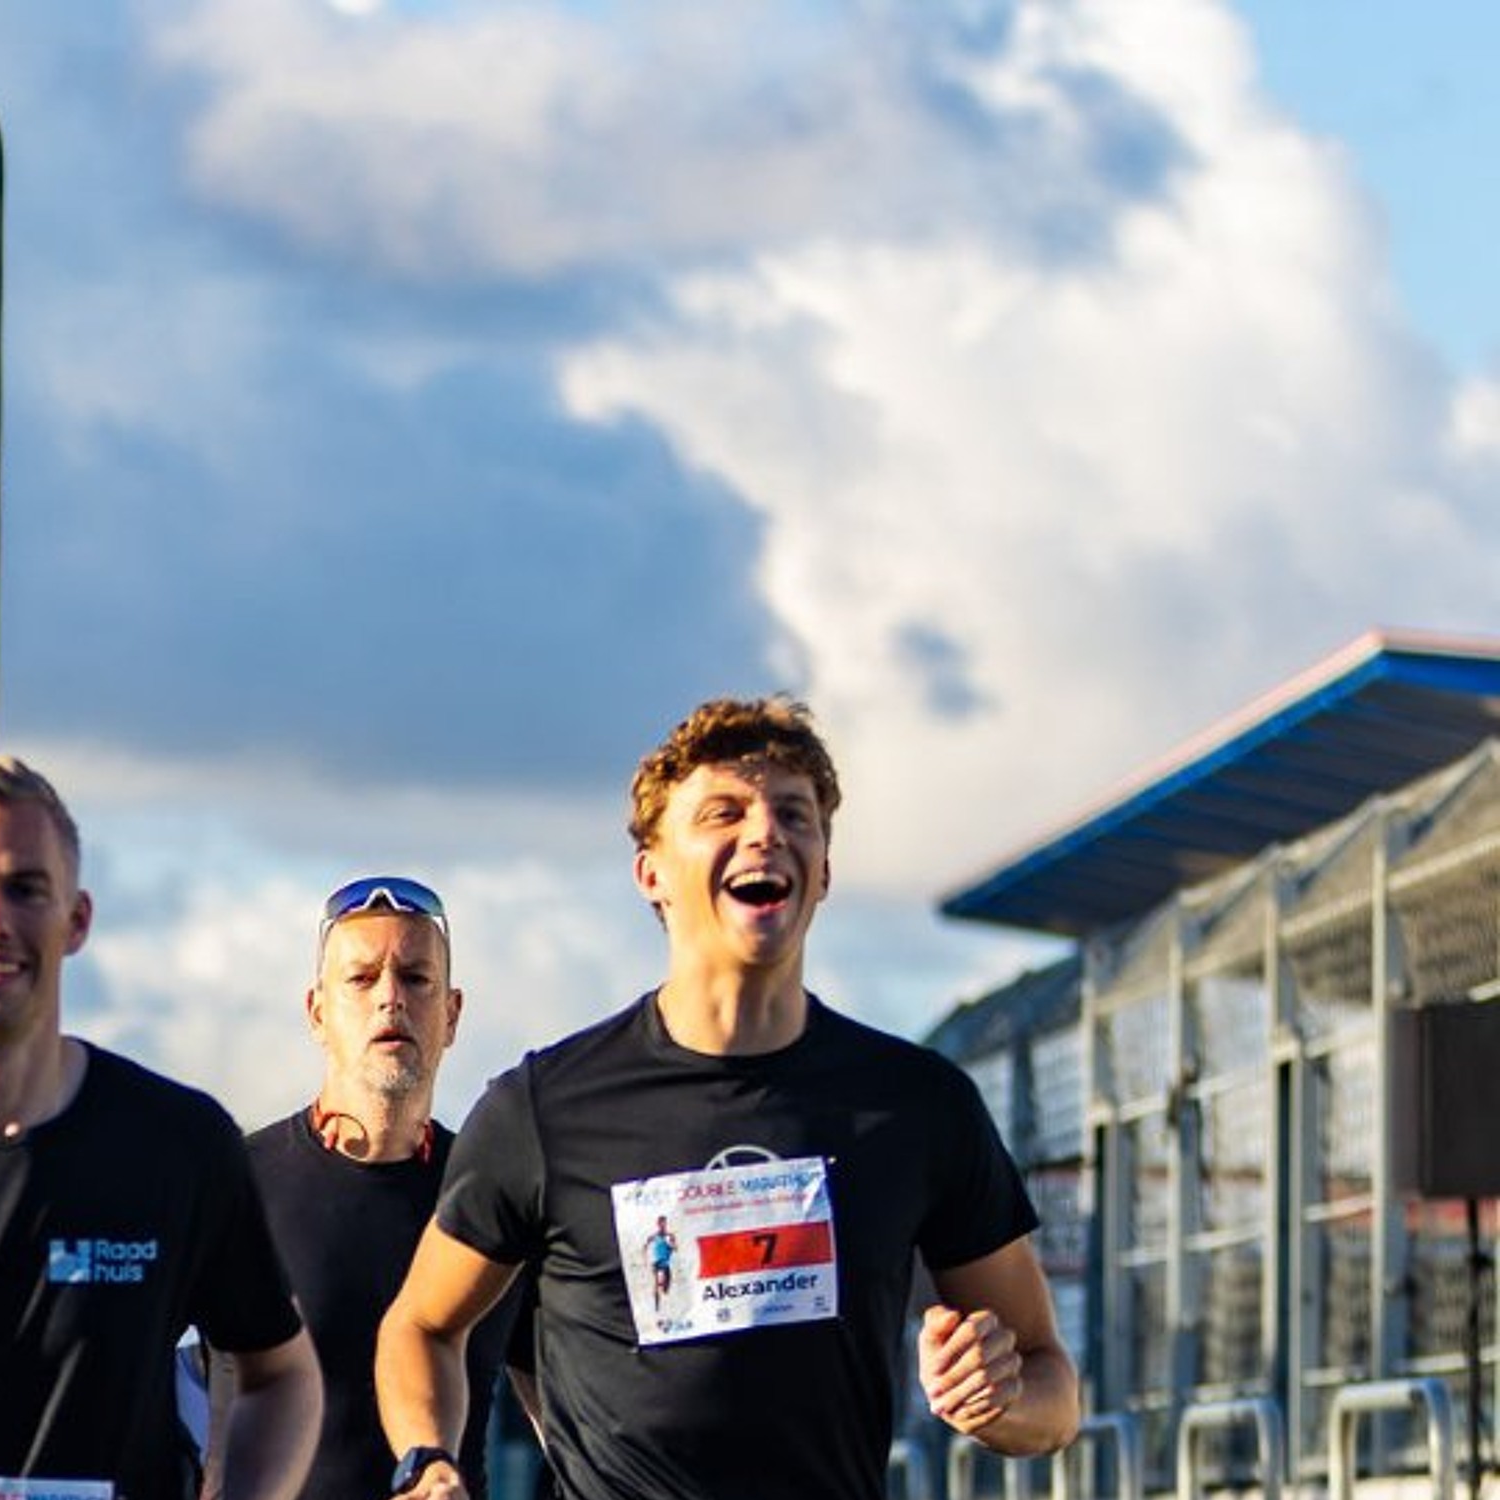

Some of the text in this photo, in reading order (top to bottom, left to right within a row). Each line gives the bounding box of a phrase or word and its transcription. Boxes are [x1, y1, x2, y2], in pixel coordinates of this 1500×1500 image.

[95, 1239, 157, 1260] Raad
[752, 1233, 778, 1265] 7
[94, 1260, 143, 1283] huis
[702, 1273, 818, 1301] Alexander
